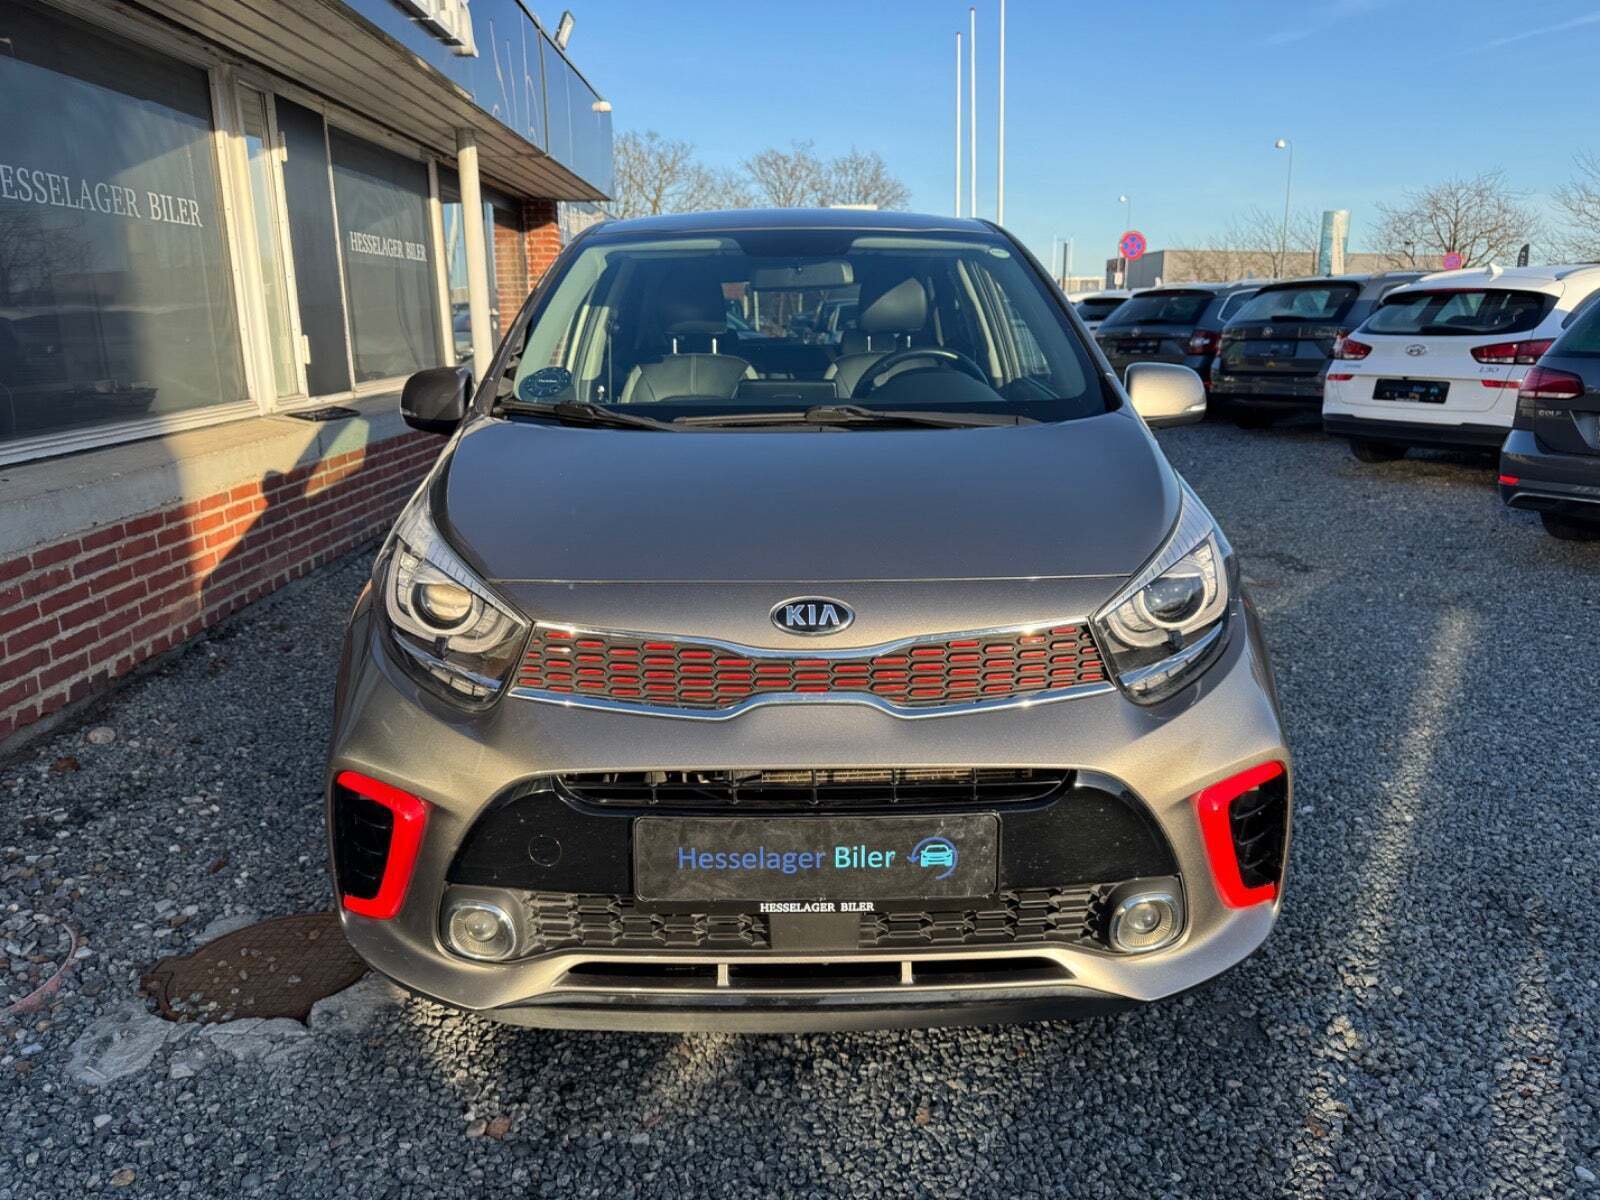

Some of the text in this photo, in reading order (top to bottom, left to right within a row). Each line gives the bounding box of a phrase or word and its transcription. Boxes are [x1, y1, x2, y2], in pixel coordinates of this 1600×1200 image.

[148, 191, 204, 228] BILER
[349, 231, 428, 262] HESSELAGER BILER
[785, 604, 840, 626] KIA
[677, 844, 897, 875] Hesselager Biler
[760, 902, 875, 913] HESSELAGER BILER
